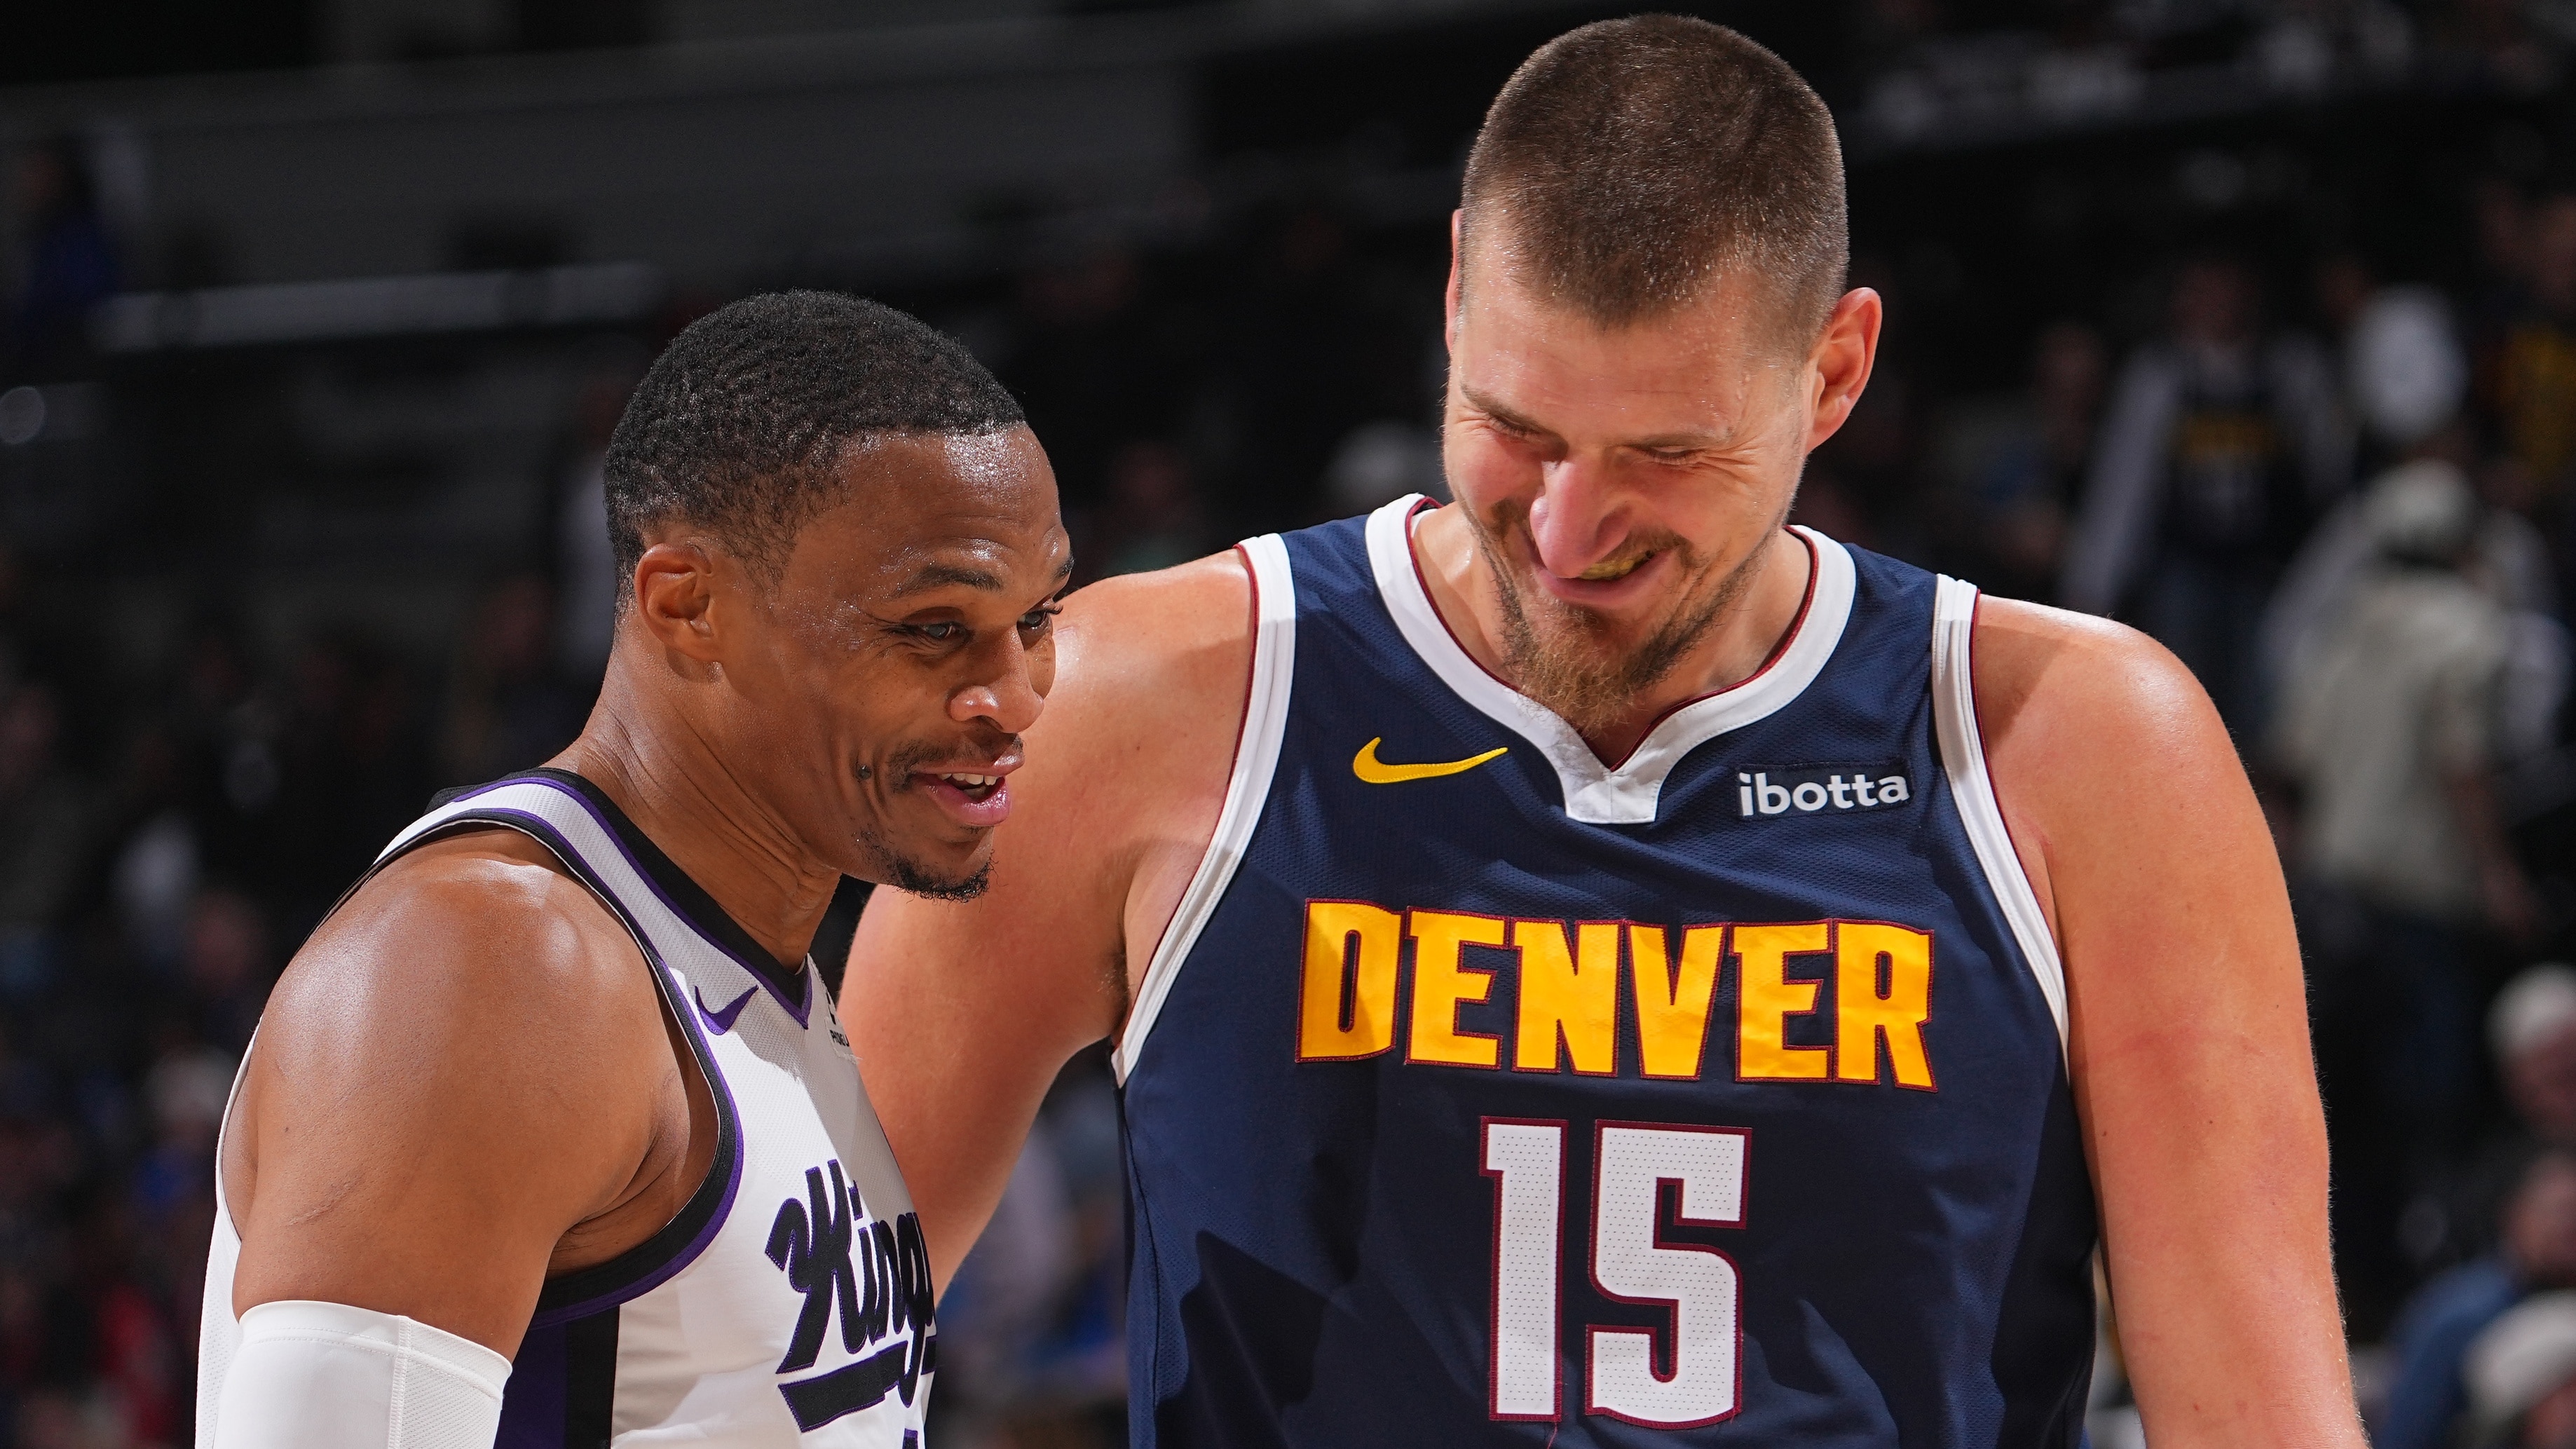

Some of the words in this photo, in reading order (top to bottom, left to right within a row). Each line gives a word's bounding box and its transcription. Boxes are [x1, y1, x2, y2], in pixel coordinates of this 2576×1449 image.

[1738, 772, 1910, 816] ibotta
[1295, 897, 1938, 1092] DENVER
[1479, 1115, 1752, 1430] 15
